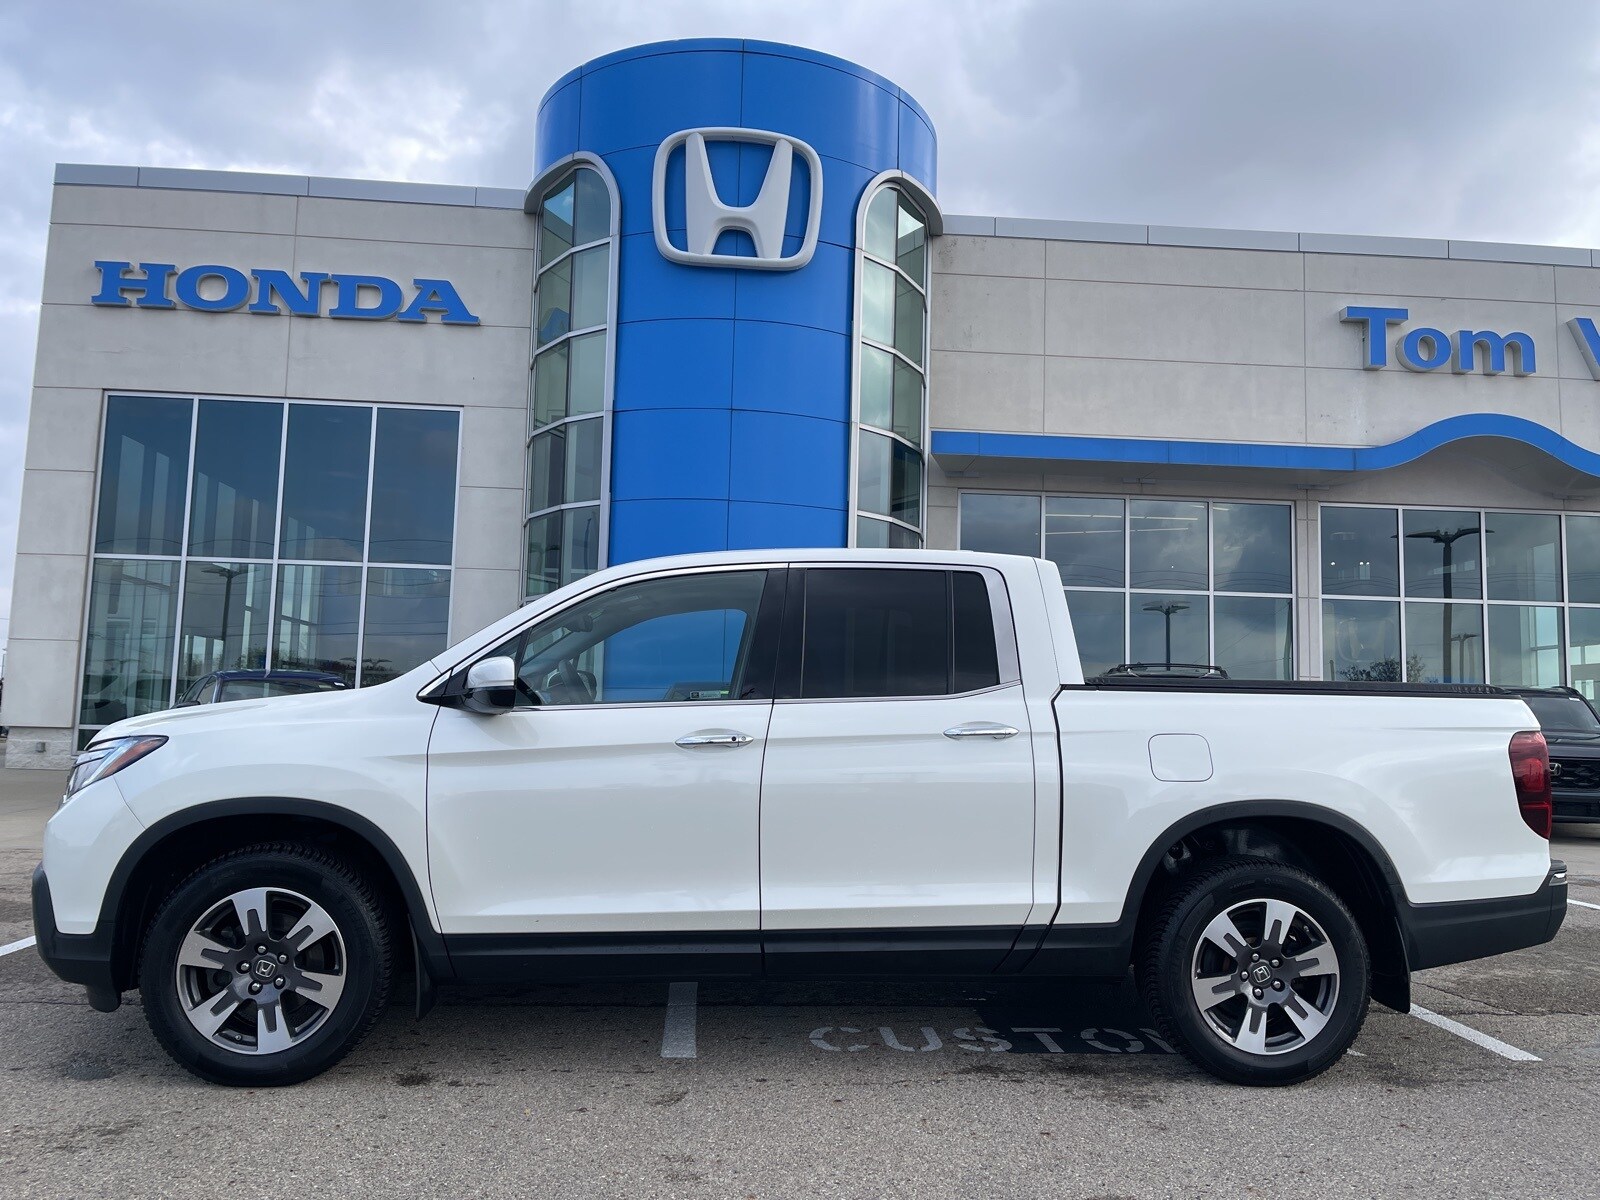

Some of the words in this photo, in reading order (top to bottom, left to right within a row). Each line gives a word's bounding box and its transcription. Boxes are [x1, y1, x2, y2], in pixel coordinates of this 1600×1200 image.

[91, 260, 481, 326] HONDA
[1339, 305, 1537, 377] Tom
[807, 1026, 1179, 1054] CUSTO
